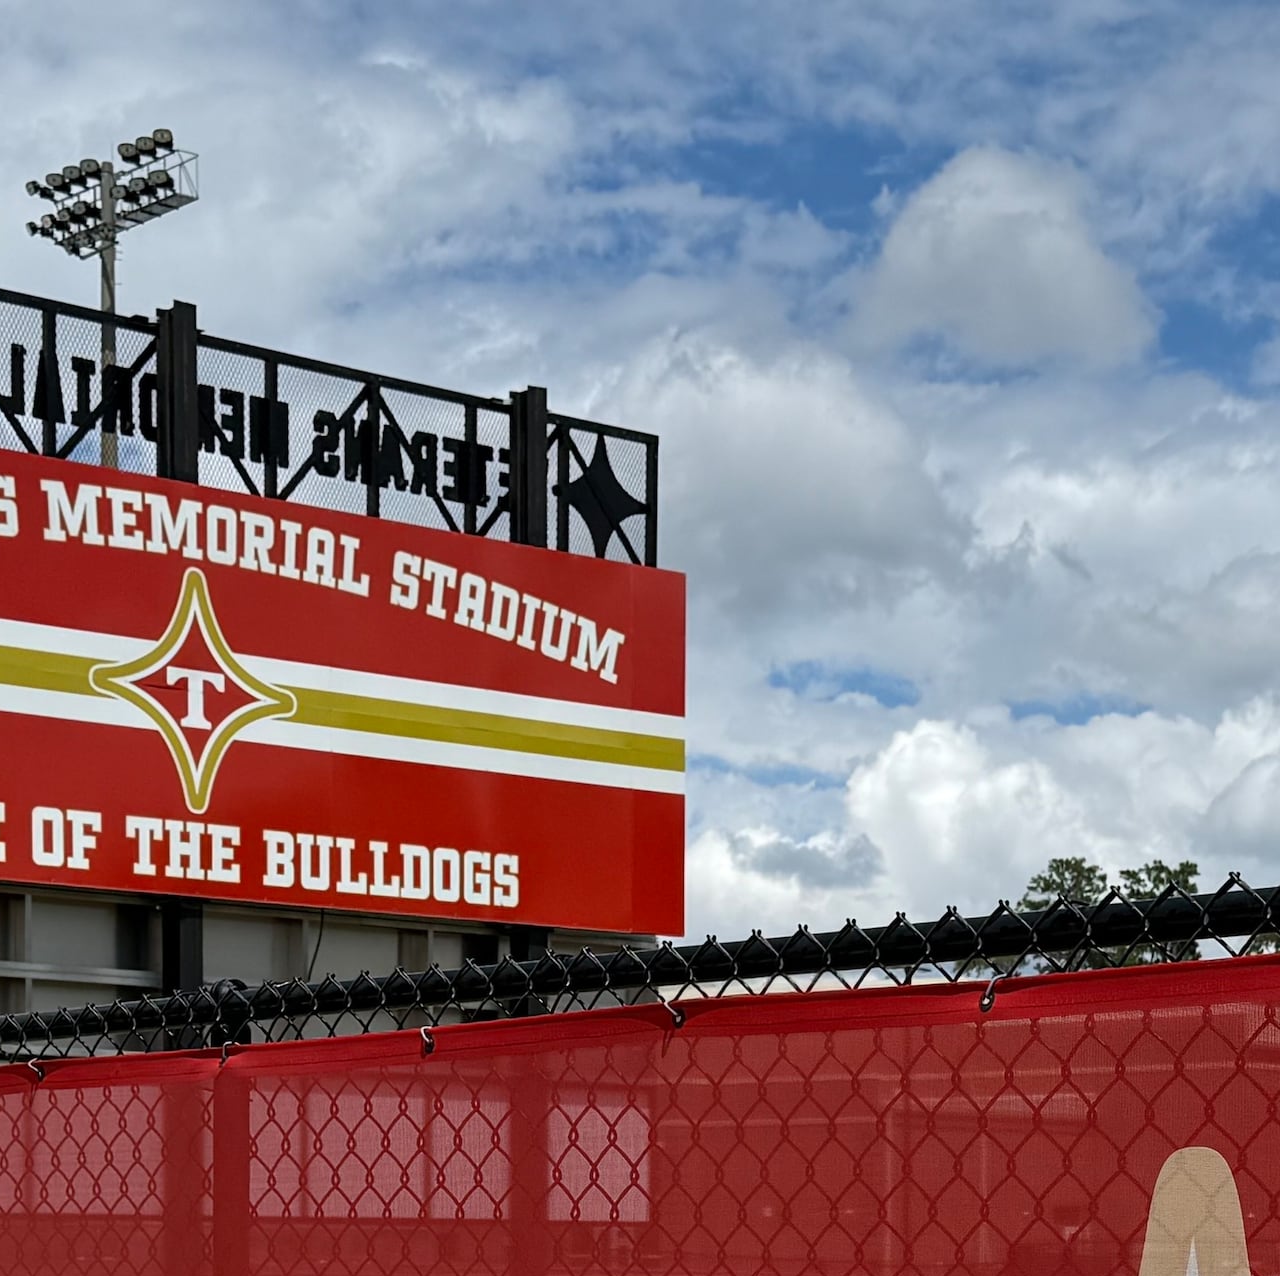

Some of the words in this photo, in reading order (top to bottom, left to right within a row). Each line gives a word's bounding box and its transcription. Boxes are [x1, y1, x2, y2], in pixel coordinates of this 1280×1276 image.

[40, 479, 370, 597] MEMORIAL
[390, 550, 625, 685] STADIUM
[166, 665, 226, 731] T
[31, 806, 103, 870] OF
[125, 815, 241, 883] THE
[262, 829, 521, 908] BULLDOGS
